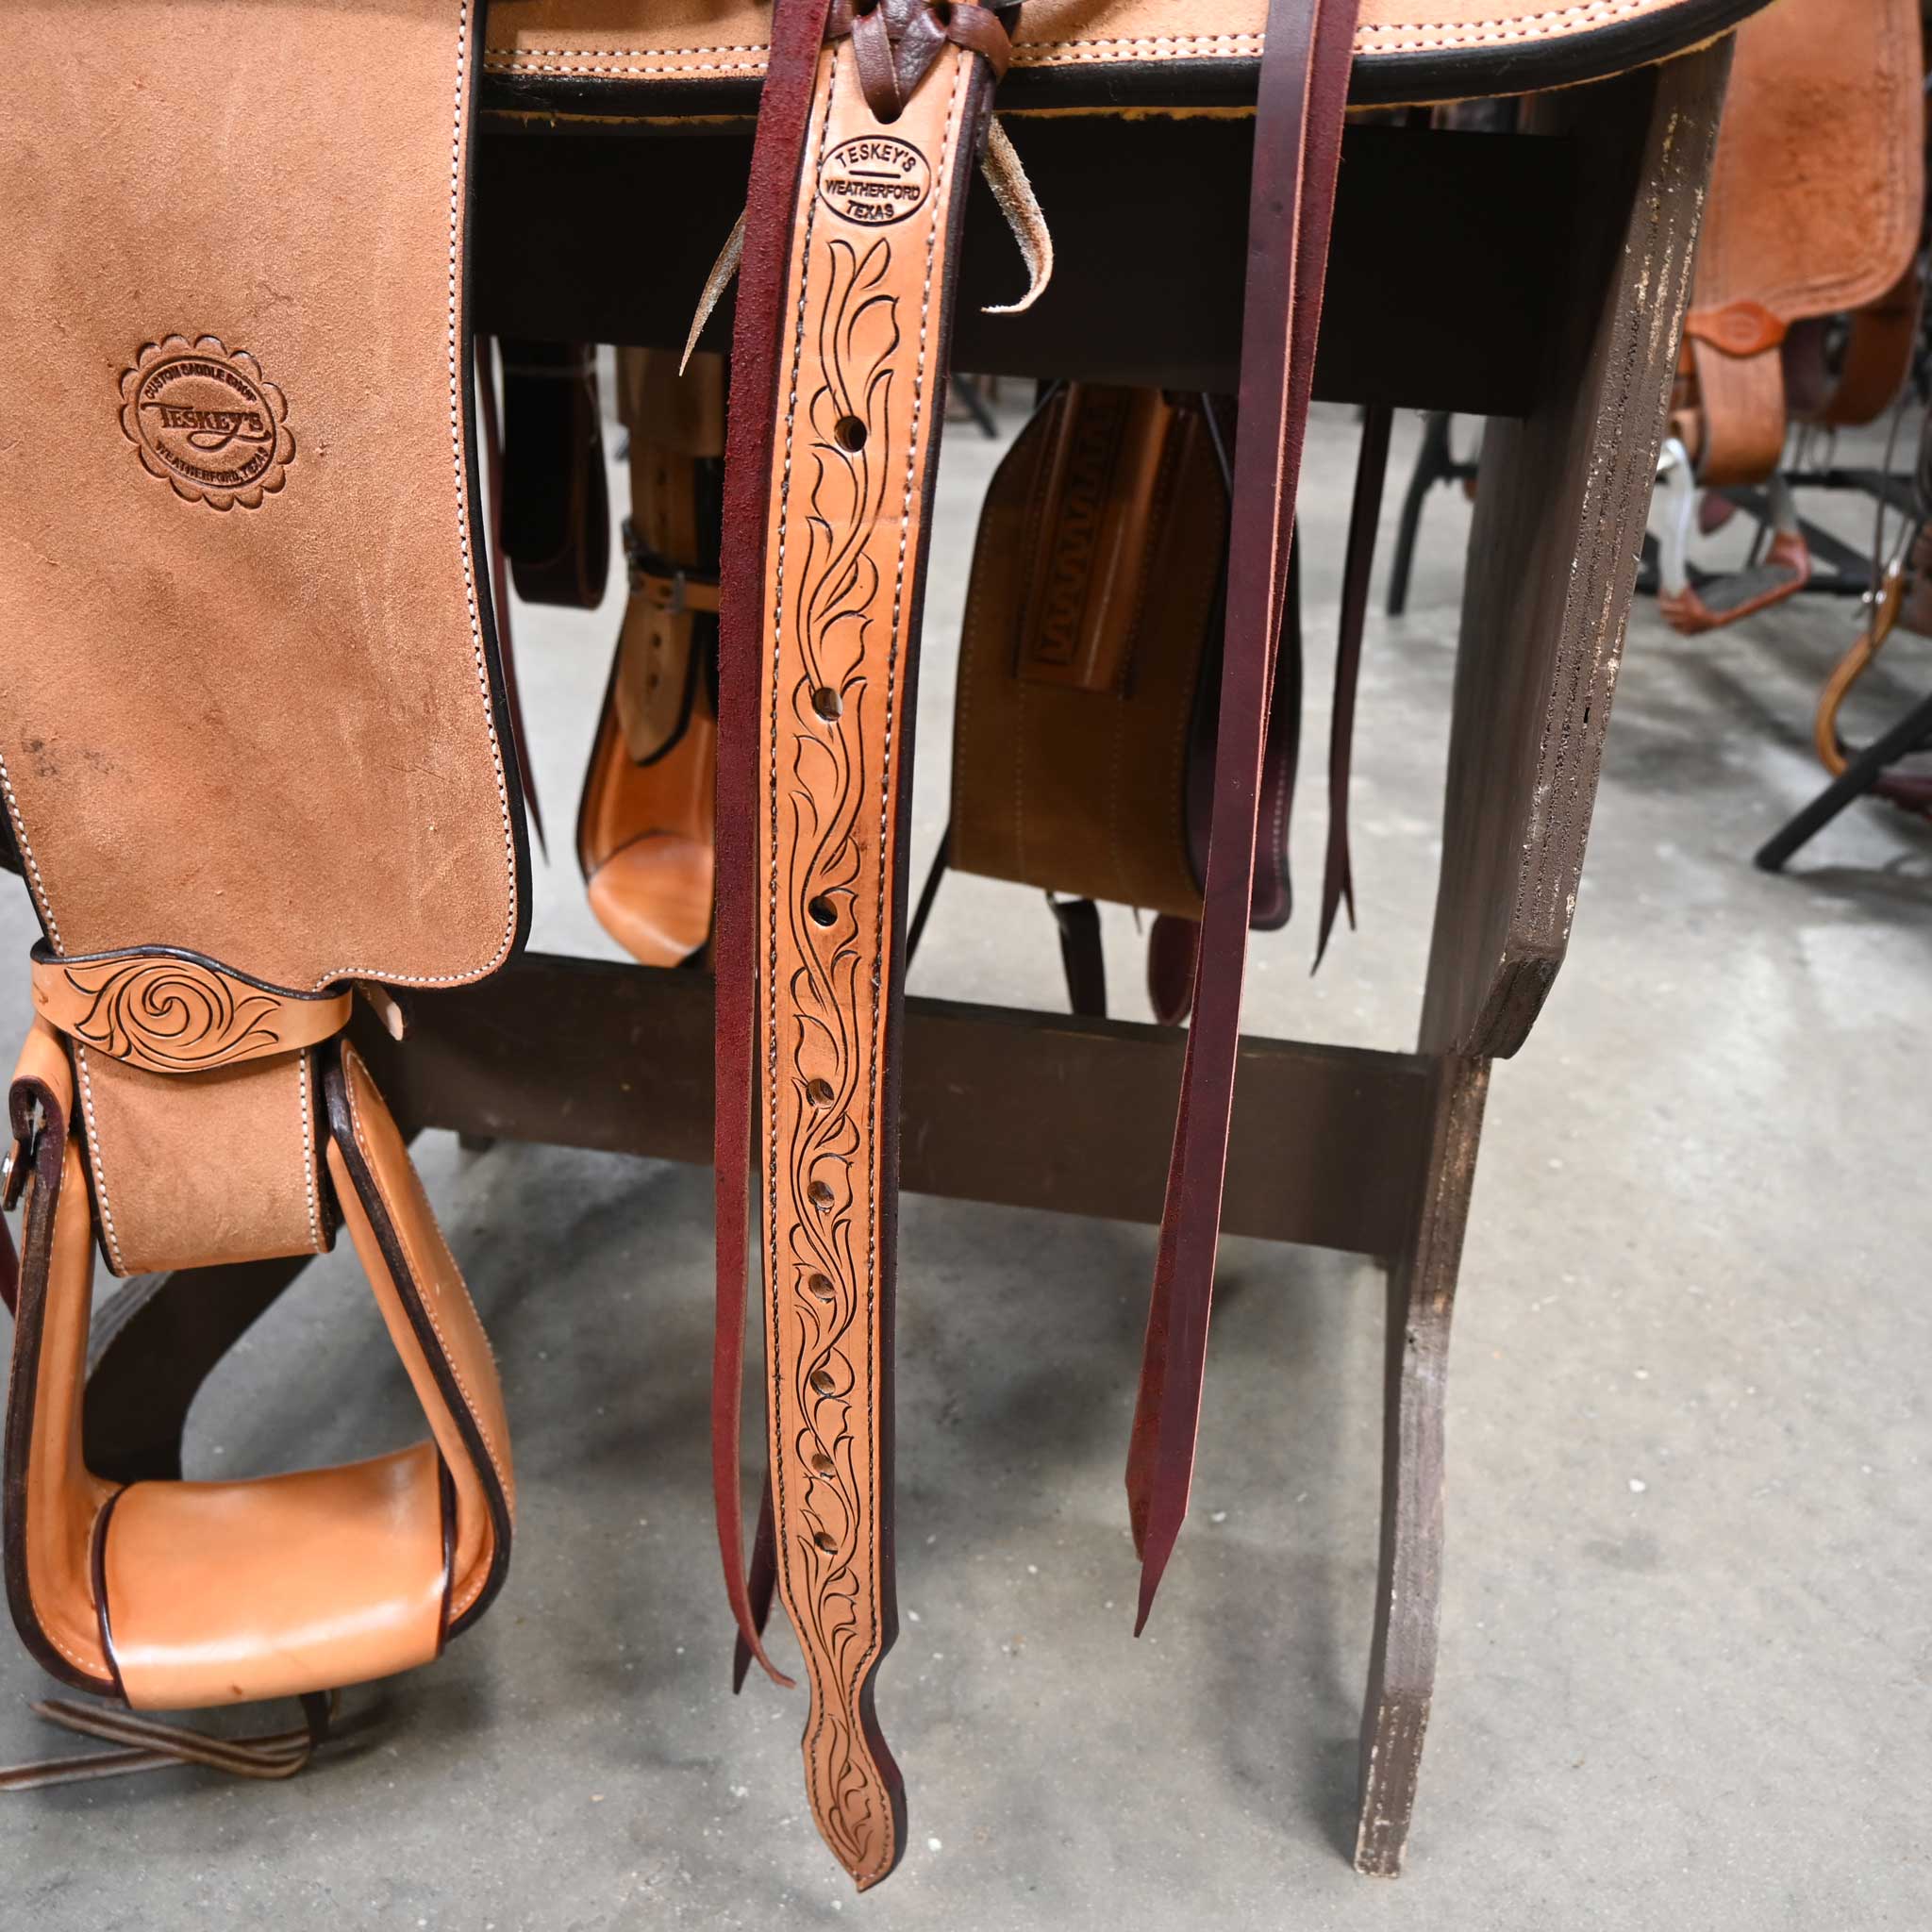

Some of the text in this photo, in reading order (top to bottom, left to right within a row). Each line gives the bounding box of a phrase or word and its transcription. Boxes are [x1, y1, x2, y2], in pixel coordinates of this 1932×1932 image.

[835, 143, 916, 173] TESKEY'S
[825, 179, 921, 201] WEATHERFORD
[846, 199, 894, 220] TEXAS
[144, 366, 182, 400] CUSTOM
[181, 362, 225, 383] SADDLE
[141, 402, 272, 453] TESKEY'S
